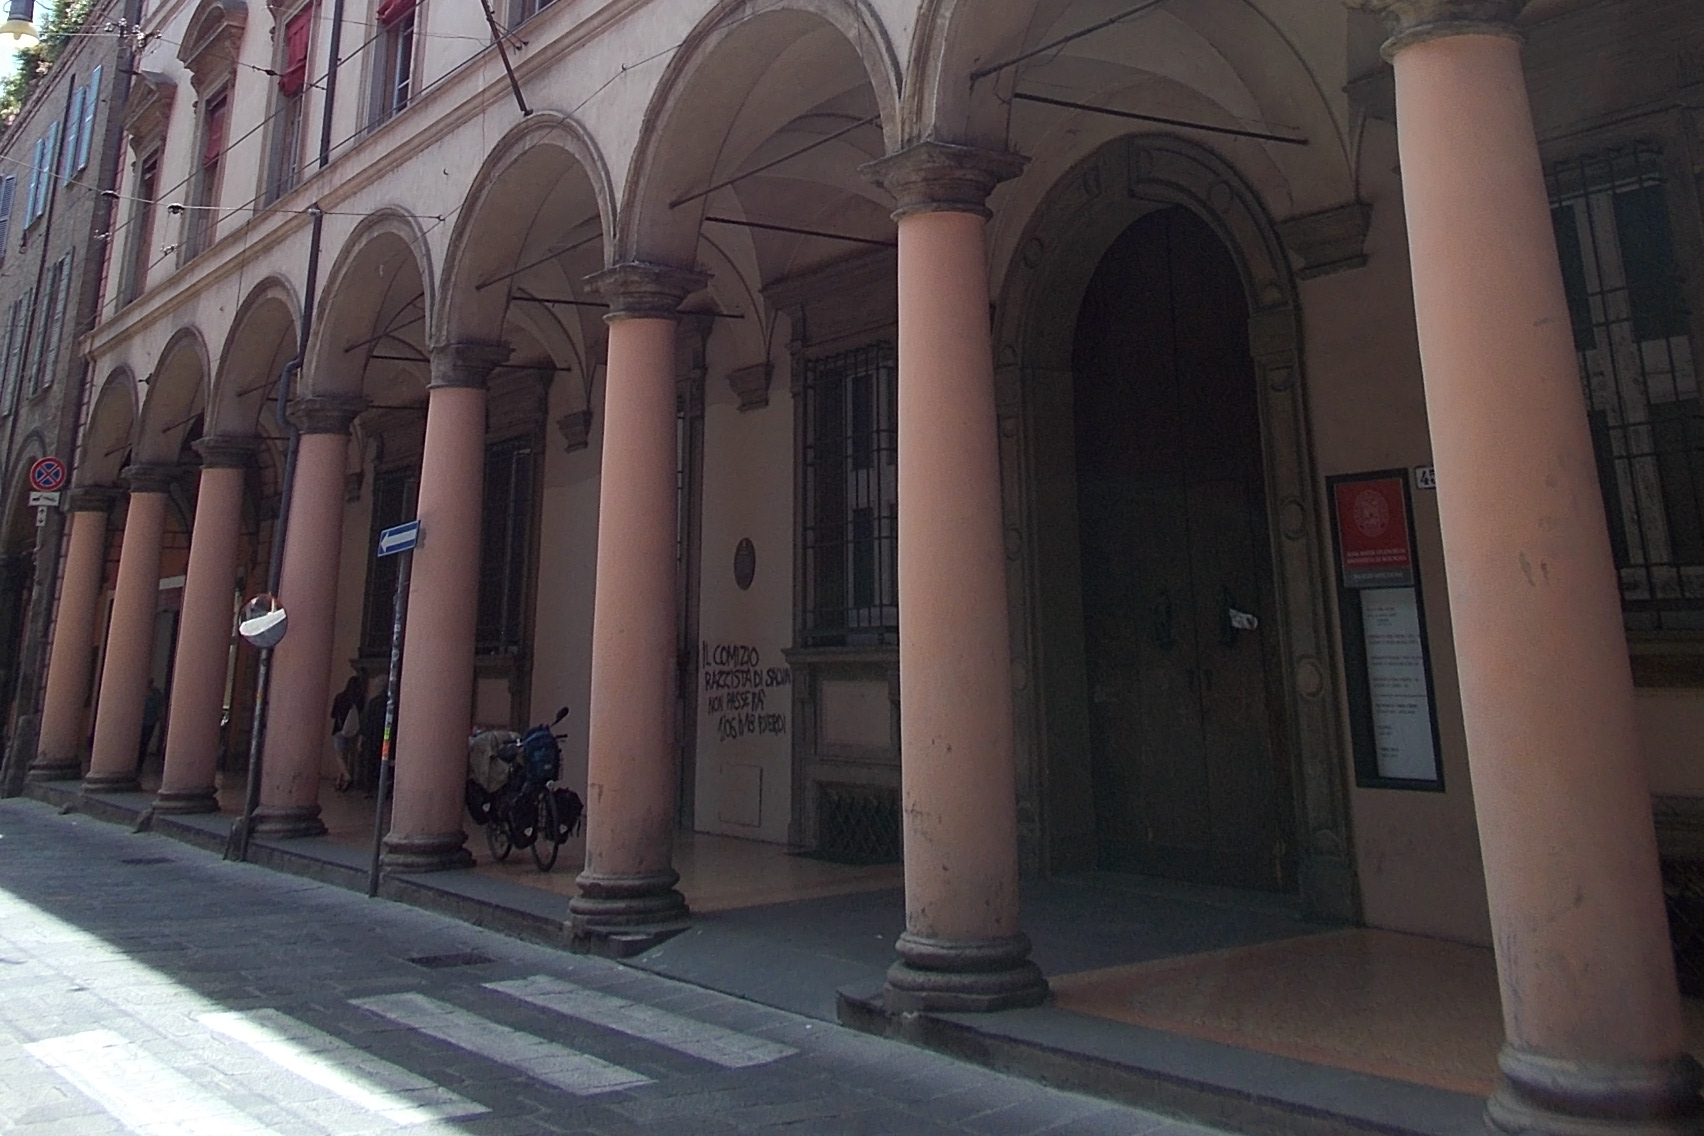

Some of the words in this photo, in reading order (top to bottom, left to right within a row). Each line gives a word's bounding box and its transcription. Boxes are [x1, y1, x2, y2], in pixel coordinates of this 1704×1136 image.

[702, 640, 712, 669] IL
[713, 644, 760, 668] COMIZIO
[704, 668, 752, 692] RAZZISTA
[753, 669, 763, 688] DI
